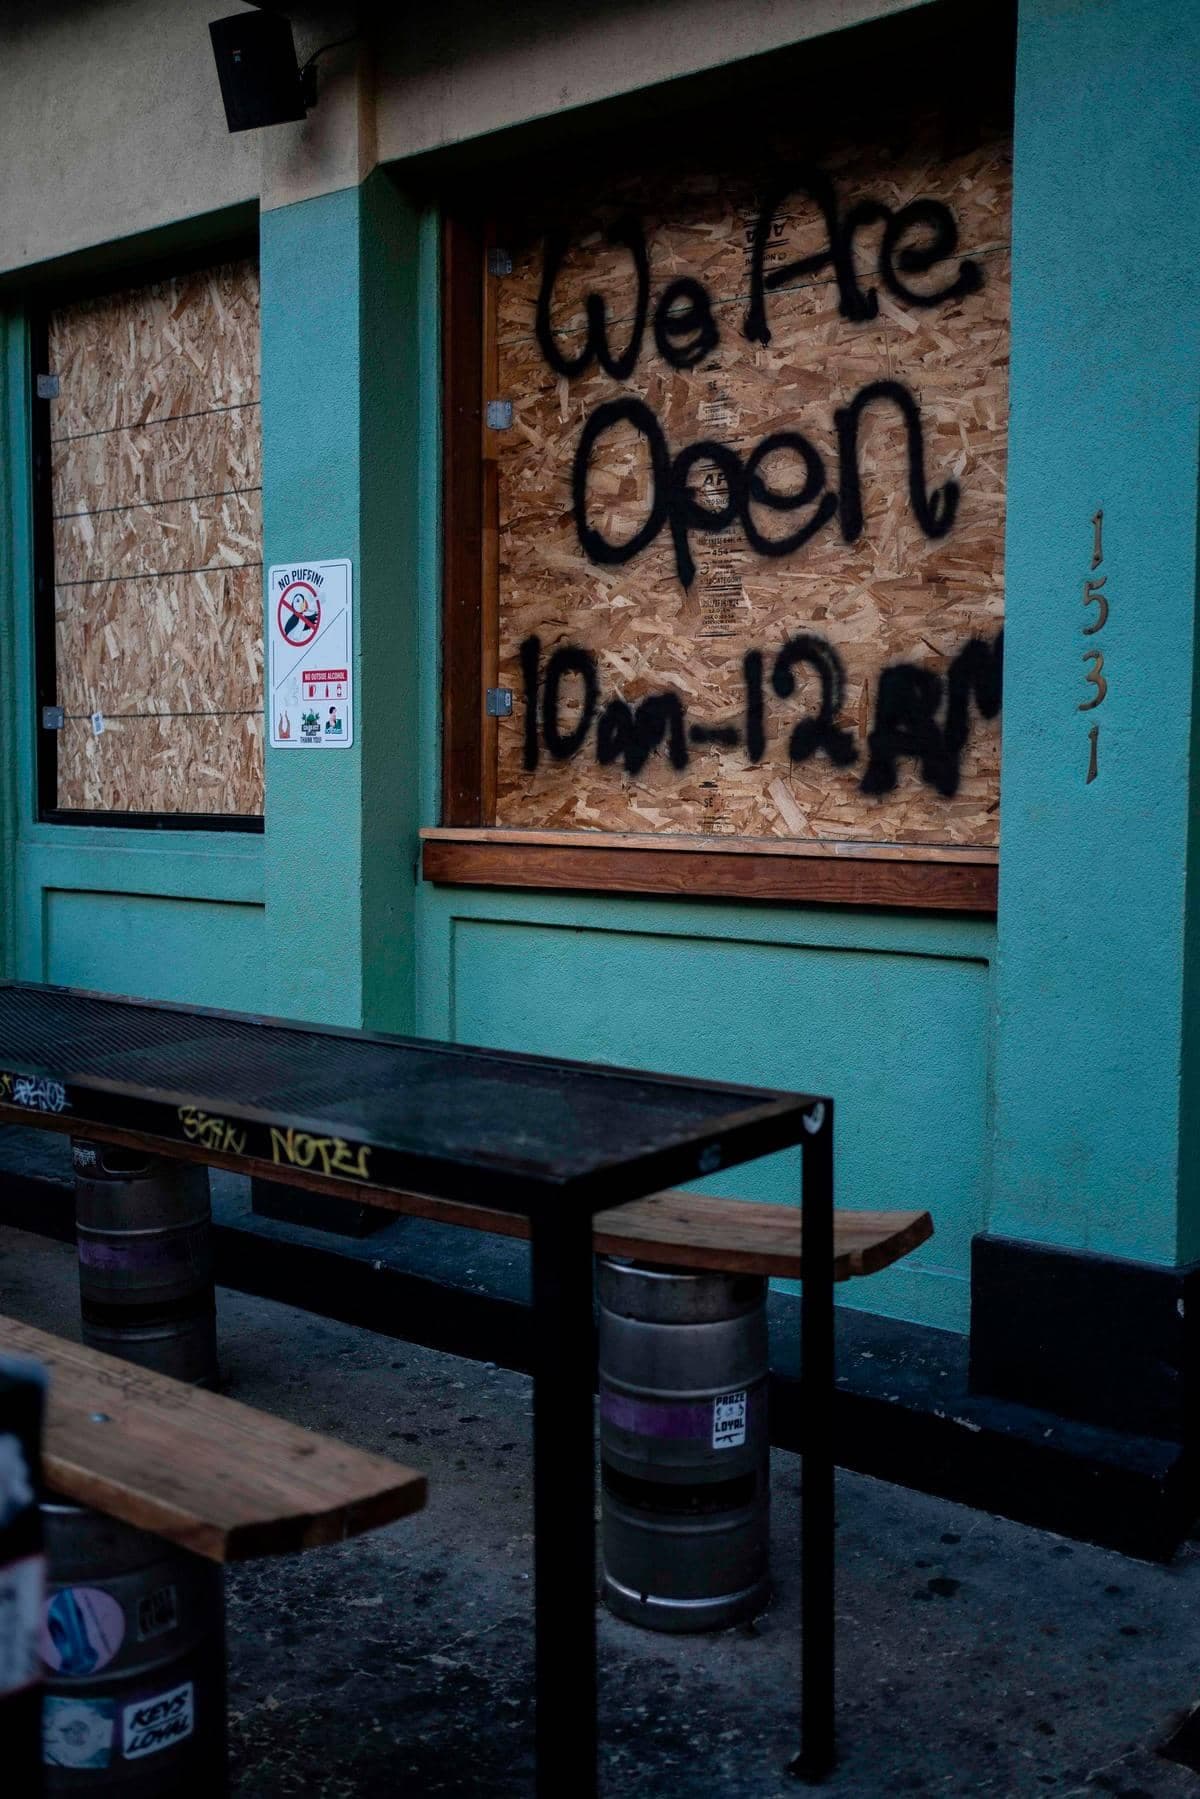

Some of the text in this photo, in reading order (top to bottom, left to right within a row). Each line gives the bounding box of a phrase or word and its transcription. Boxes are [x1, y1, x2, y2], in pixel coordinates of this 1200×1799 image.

[536, 172, 986, 380] We Are
[278, 574, 290, 591] NO
[571, 380, 961, 590] Open
[1077, 508, 1109, 785] 1531
